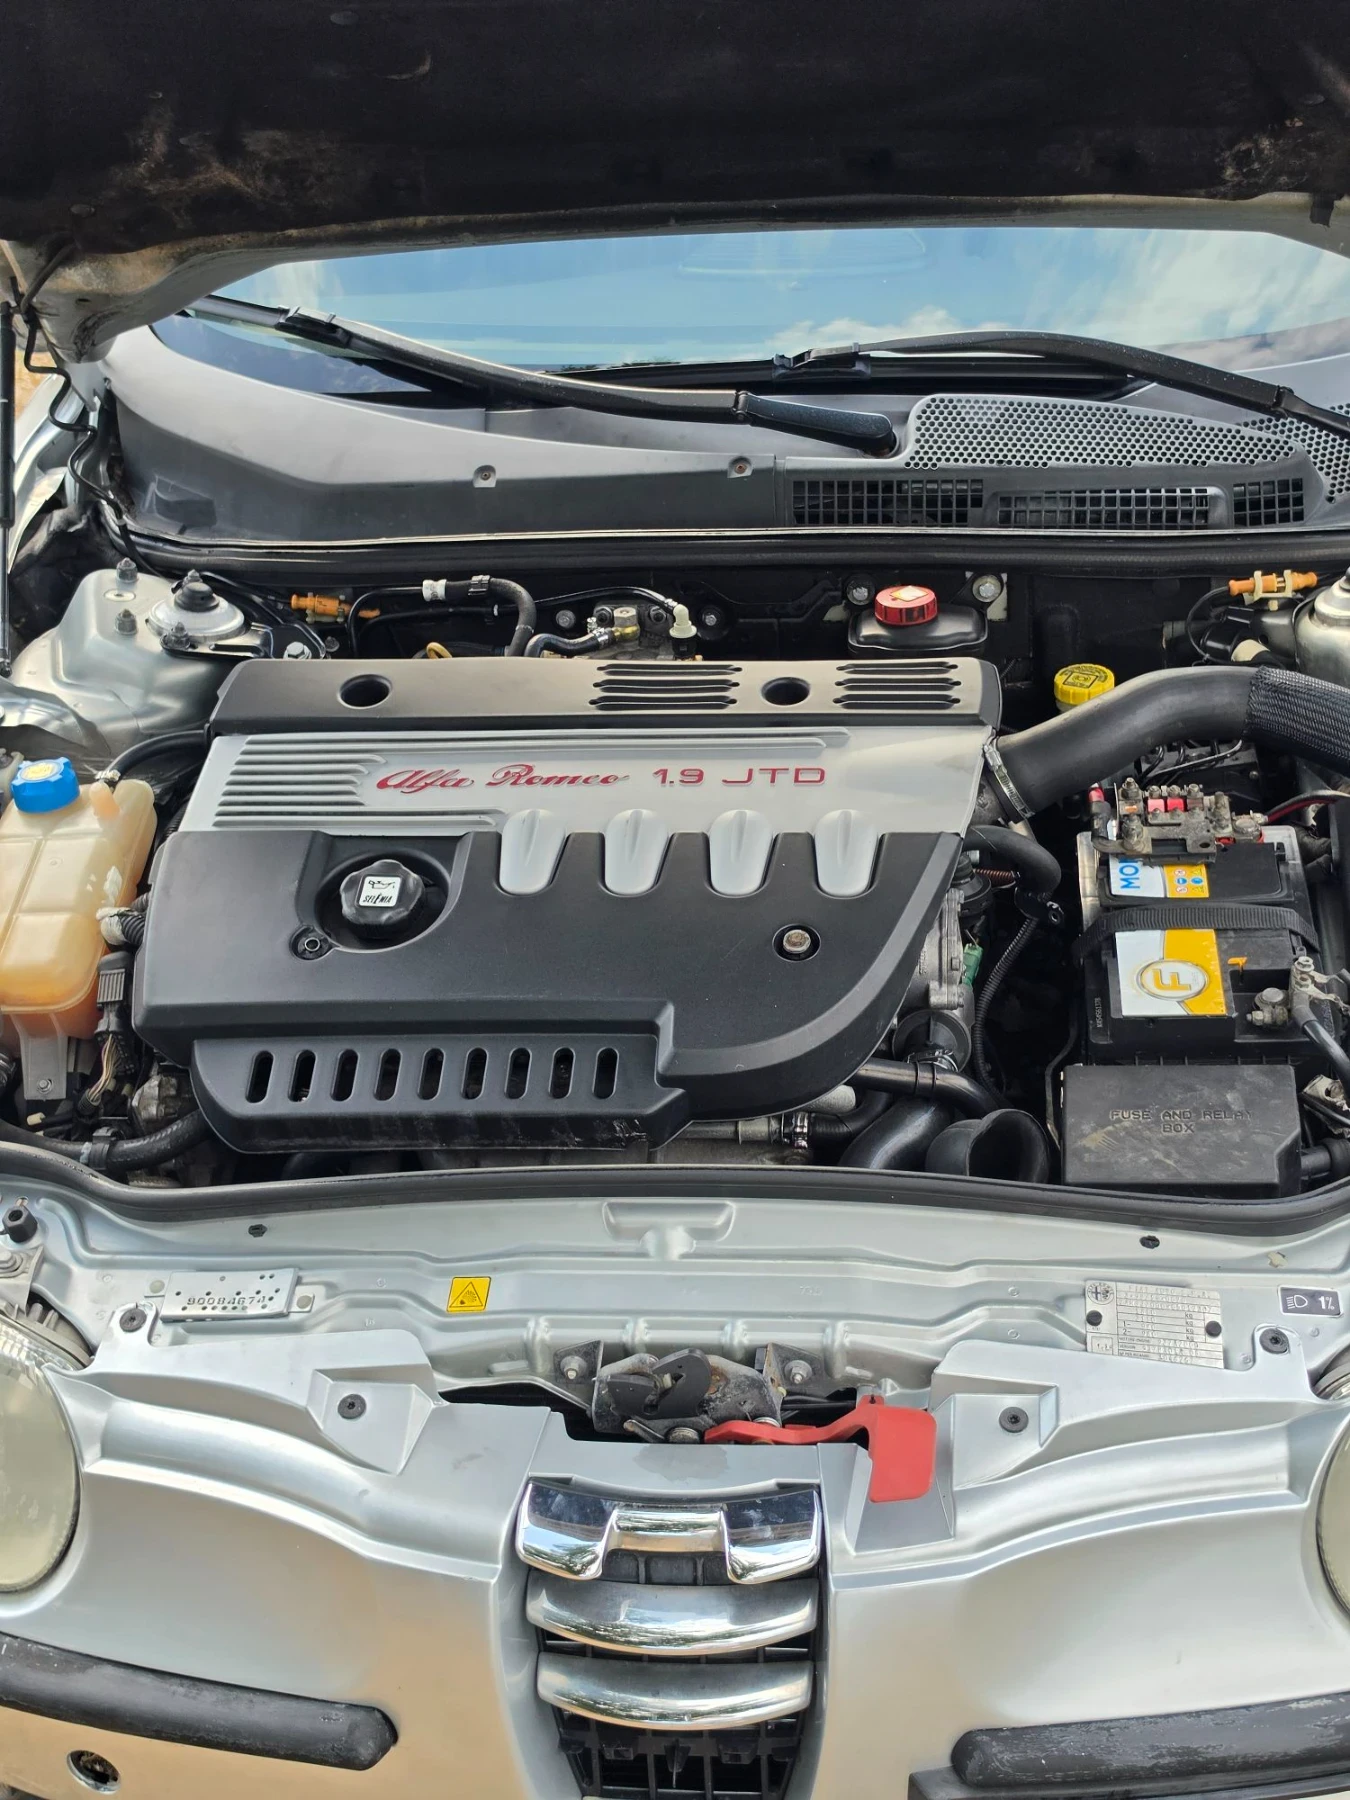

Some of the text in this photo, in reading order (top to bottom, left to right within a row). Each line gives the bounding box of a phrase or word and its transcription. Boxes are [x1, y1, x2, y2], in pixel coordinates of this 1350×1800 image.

[376, 763, 826, 794] Alfa Romeo 1.9 JTD
[1152, 968, 1191, 991] F
[1110, 1109, 1253, 1121] FUSE AND RELAY
[1161, 1122, 1195, 1134] BOX
[1318, 1295, 1335, 1310] 1%
